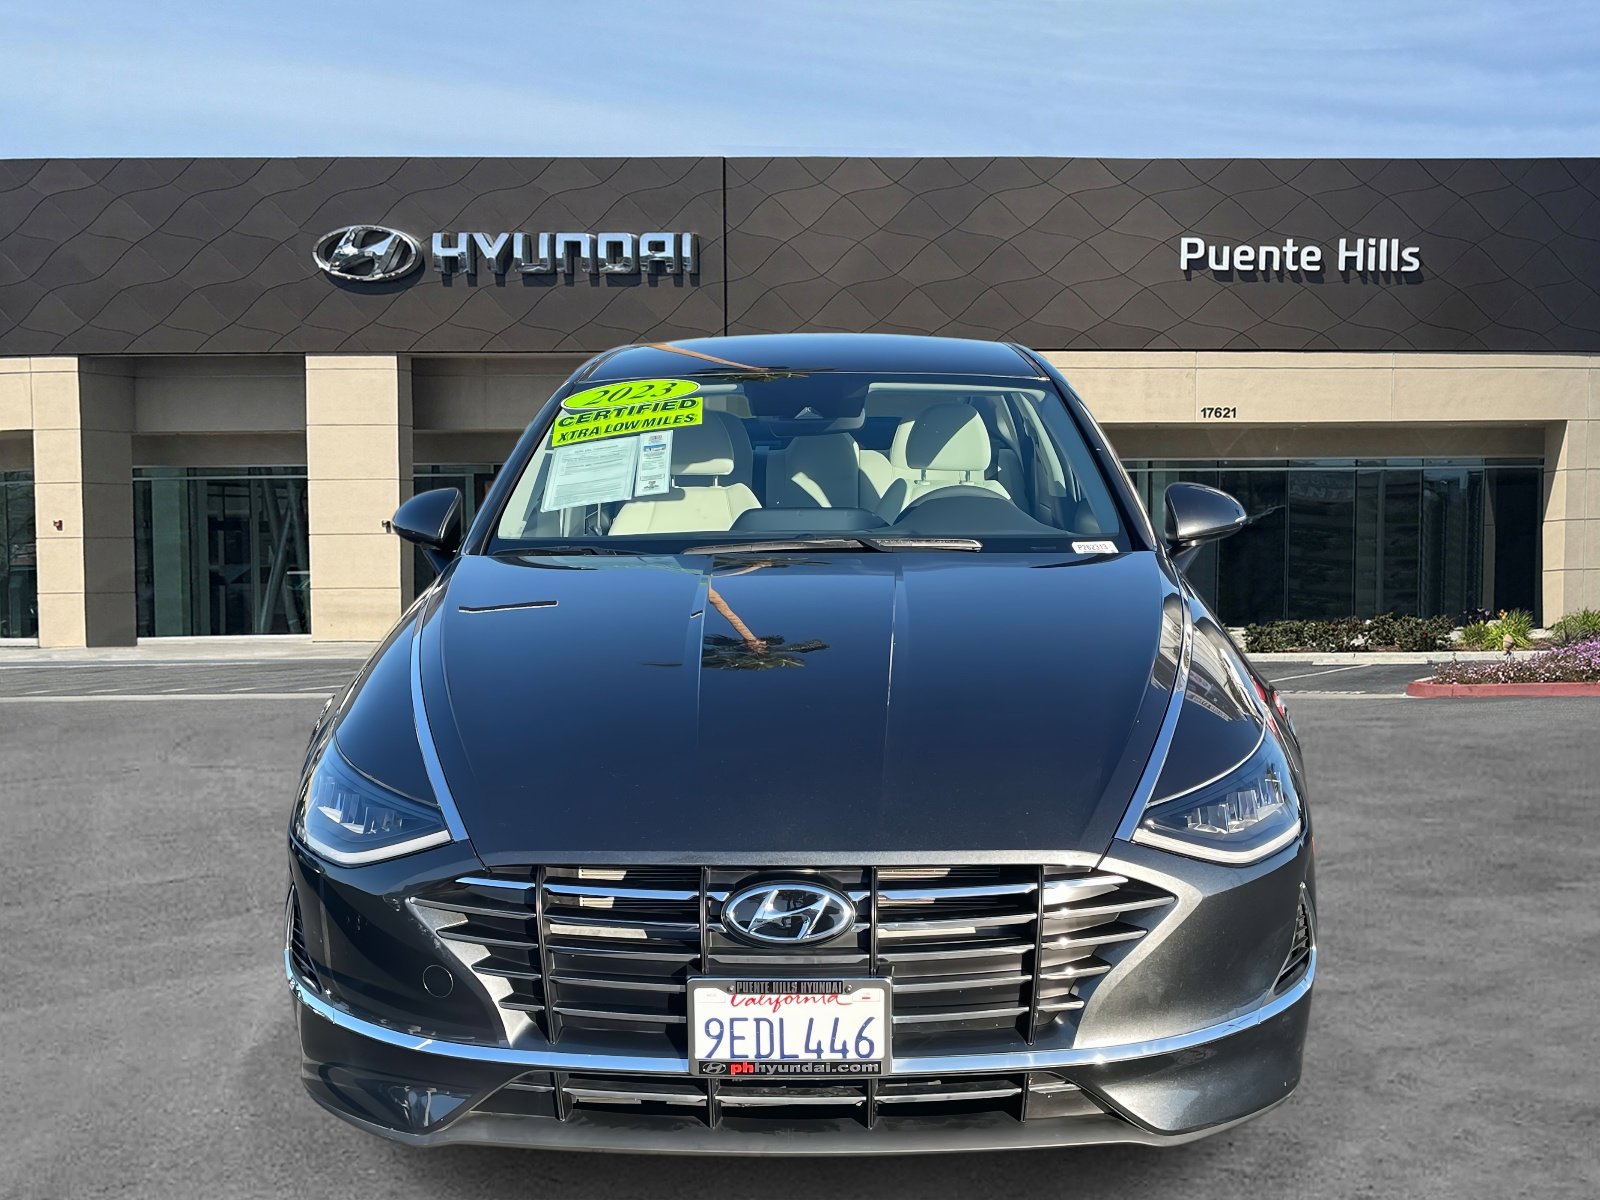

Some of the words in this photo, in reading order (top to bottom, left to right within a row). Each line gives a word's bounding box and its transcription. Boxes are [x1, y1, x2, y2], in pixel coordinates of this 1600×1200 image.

[432, 232, 699, 274] HYUNDAI
[1180, 237, 1322, 271] Puente
[1338, 238, 1420, 272] Hills
[582, 382, 678, 407] 2023
[558, 398, 698, 427] CERTIFIED
[1200, 406, 1237, 419] 17621
[559, 425, 601, 443] XTRA
[736, 981, 771, 994] PUENTE
[773, 981, 798, 994] HILLS
[800, 981, 843, 994] HYUNDAI
[730, 993, 853, 1013] California
[704, 1016, 875, 1060] 9EDL446
[730, 1061, 880, 1076] phhyundai.com
